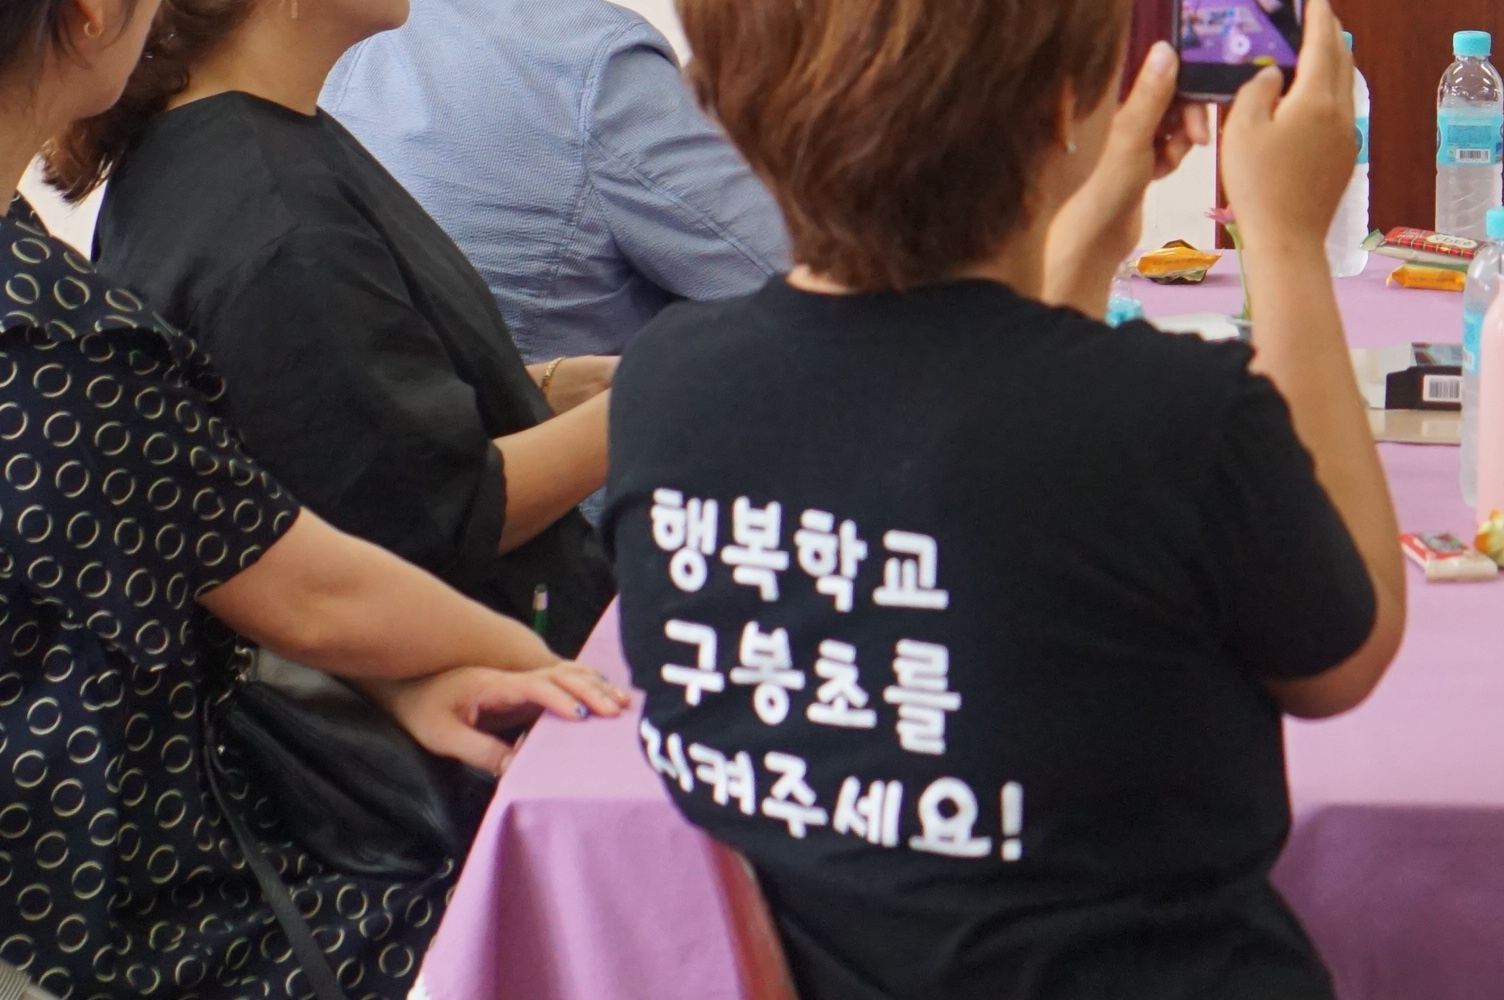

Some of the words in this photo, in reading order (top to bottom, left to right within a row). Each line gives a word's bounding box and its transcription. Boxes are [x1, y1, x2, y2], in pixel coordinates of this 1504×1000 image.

[650, 486, 950, 613] 행복학교
[660, 618, 963, 756] 구봉초를
[639, 718, 1025, 862] 지켜주세요!
